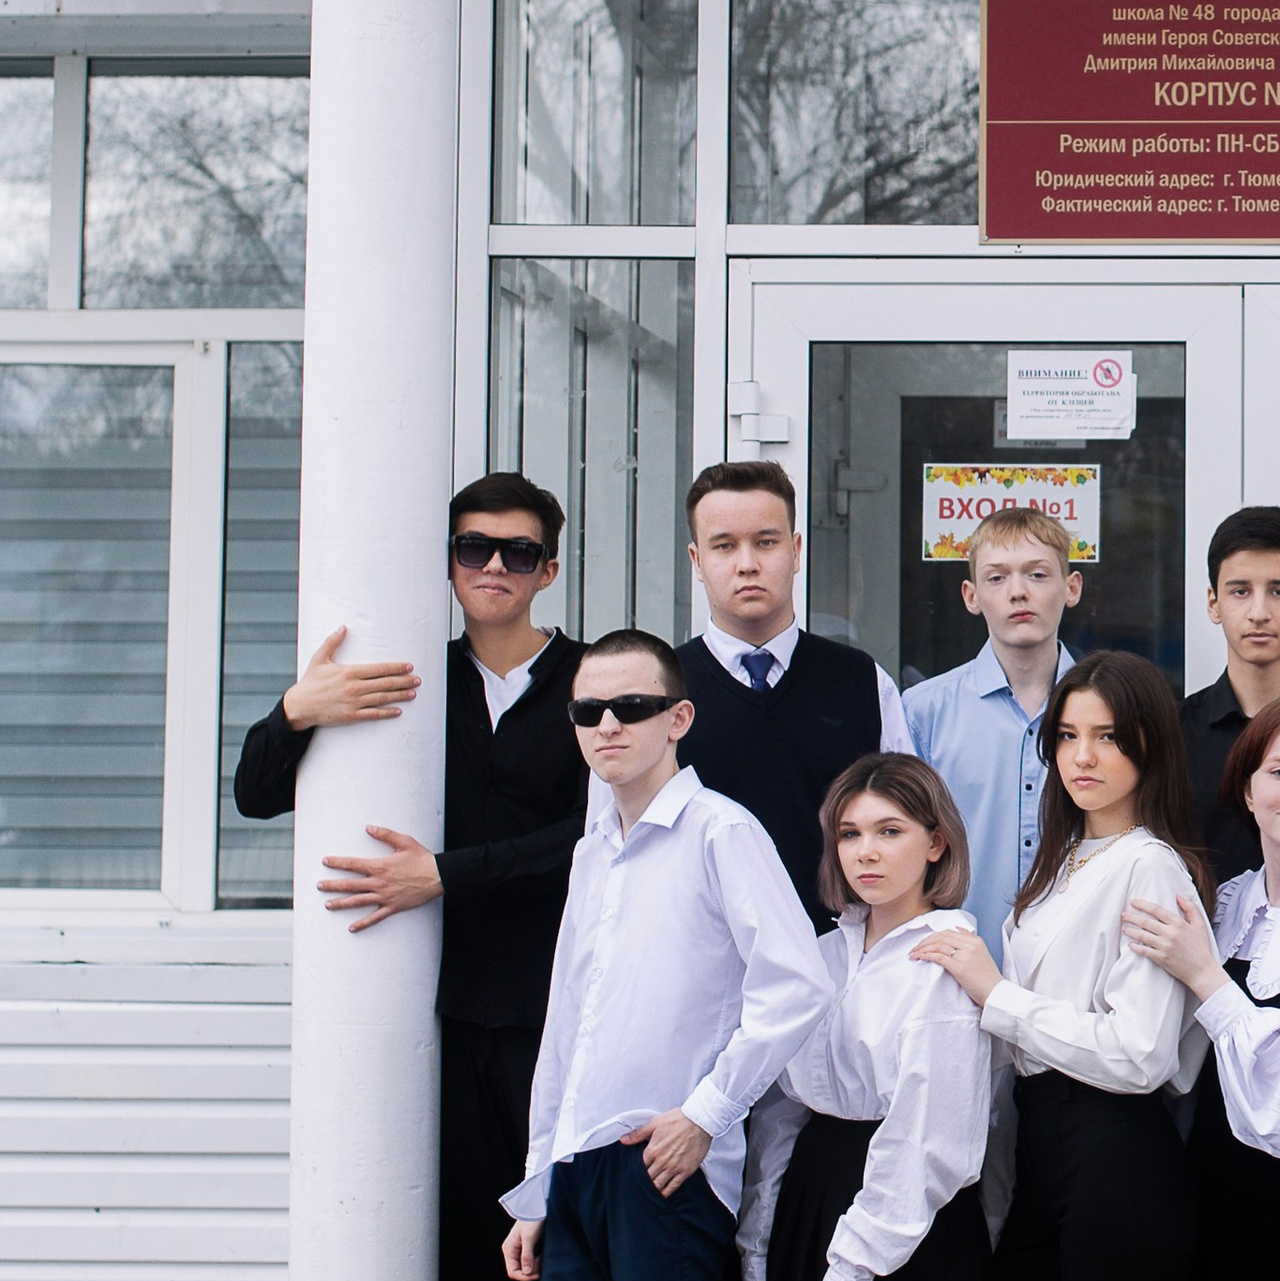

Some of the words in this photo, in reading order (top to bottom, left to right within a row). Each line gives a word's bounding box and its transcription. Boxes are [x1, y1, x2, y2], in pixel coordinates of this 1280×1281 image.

[1112, 6, 1165, 21] школа
[1169, 4, 1190, 21] №
[1192, 4, 1216, 21] 48
[1223, 6, 1280, 25] города
[1101, 31, 1157, 46] имени
[1160, 29, 1208, 50] Героя
[1083, 53, 1158, 74] Дмитрия
[1162, 53, 1276, 72] Михайловича
[1153, 80, 1258, 108] КОРПУС
[1058, 132, 1126, 155] Режим
[1131, 132, 1212, 158] работы:
[1216, 132, 1280, 154] ПН-СБ
[1035, 168, 1155, 191] Юридический
[1158, 172, 1216, 191] адрес:
[1222, 173, 1235, 188] г.
[1040, 194, 1154, 215] Фактический
[1156, 198, 1213, 217] адрес:
[1217, 199, 1229, 214] г.
